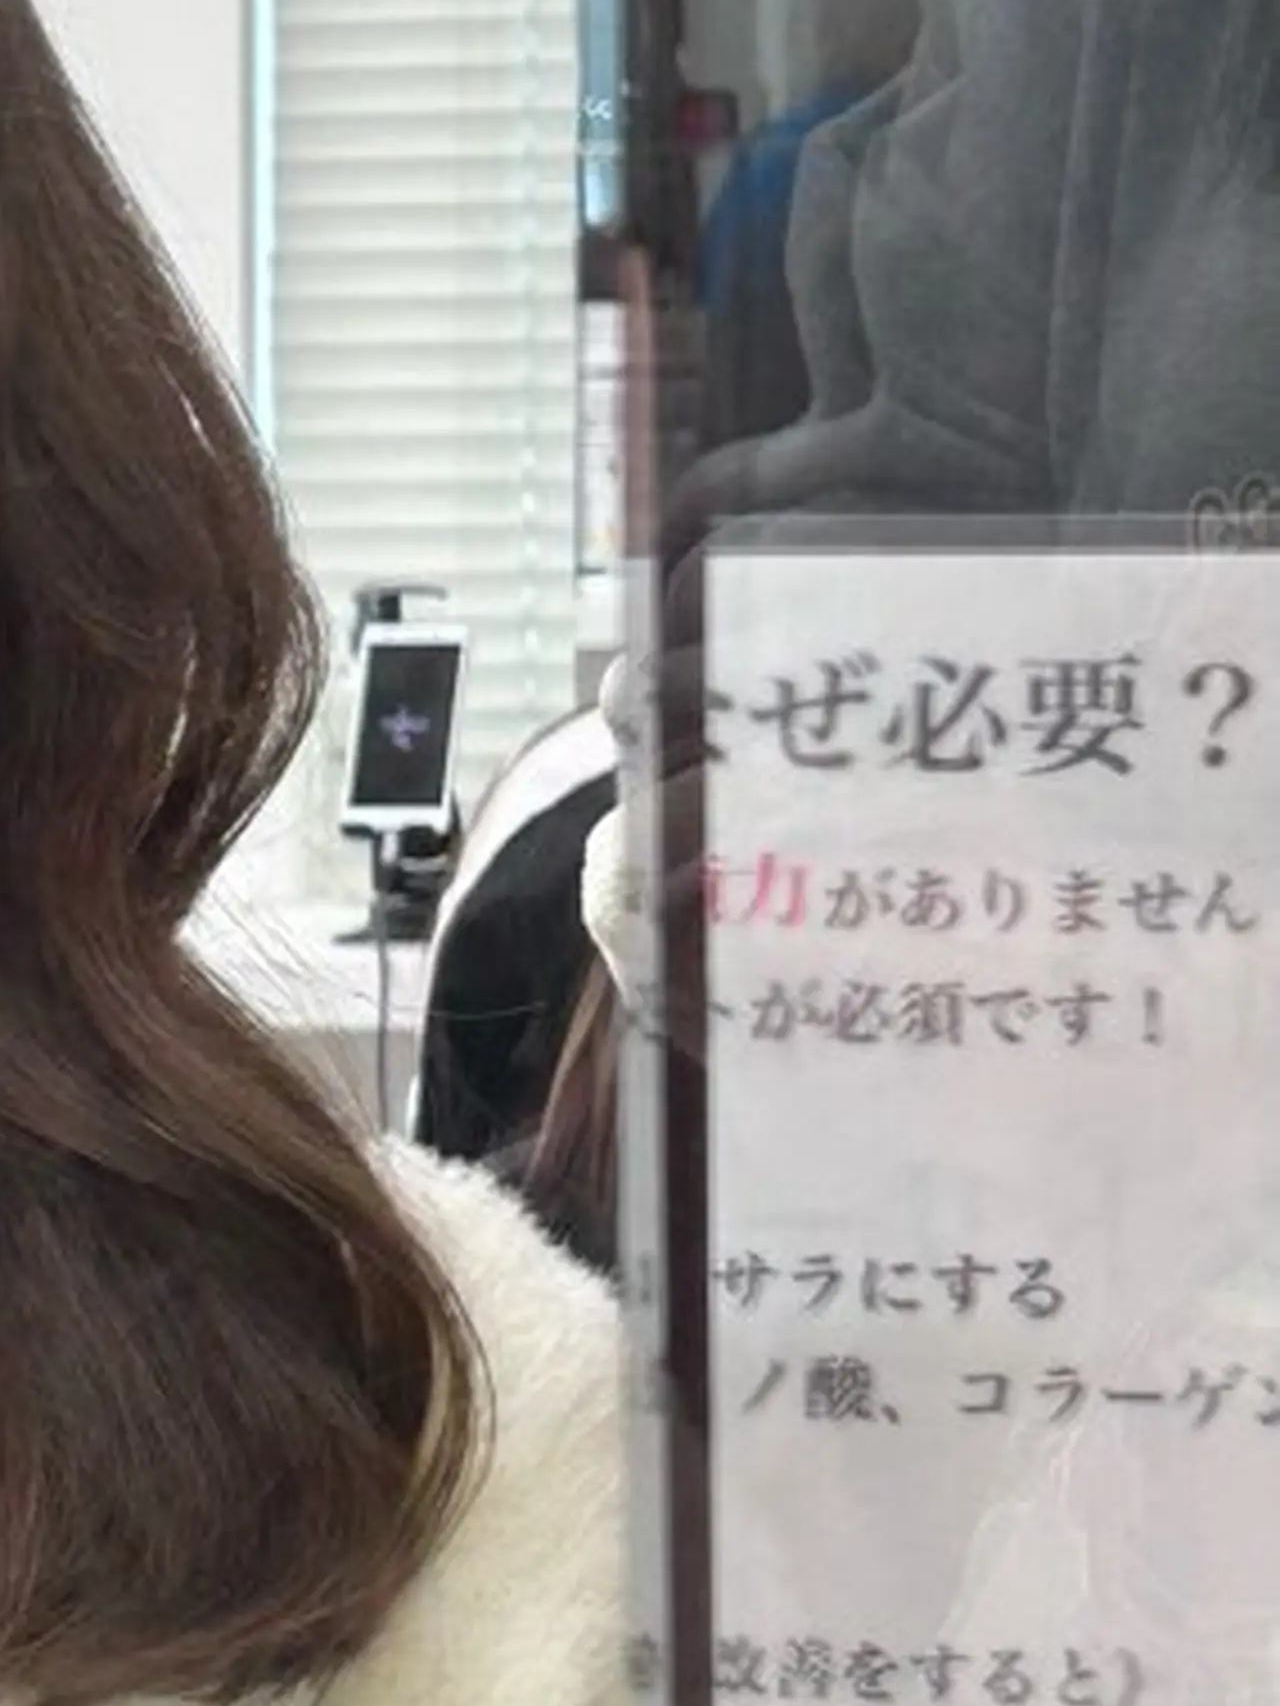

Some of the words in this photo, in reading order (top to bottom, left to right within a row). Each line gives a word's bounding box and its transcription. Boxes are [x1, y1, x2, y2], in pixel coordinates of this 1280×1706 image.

[710, 977, 1168, 1047] が必須です！
[713, 1251, 1066, 1319] サラにする
